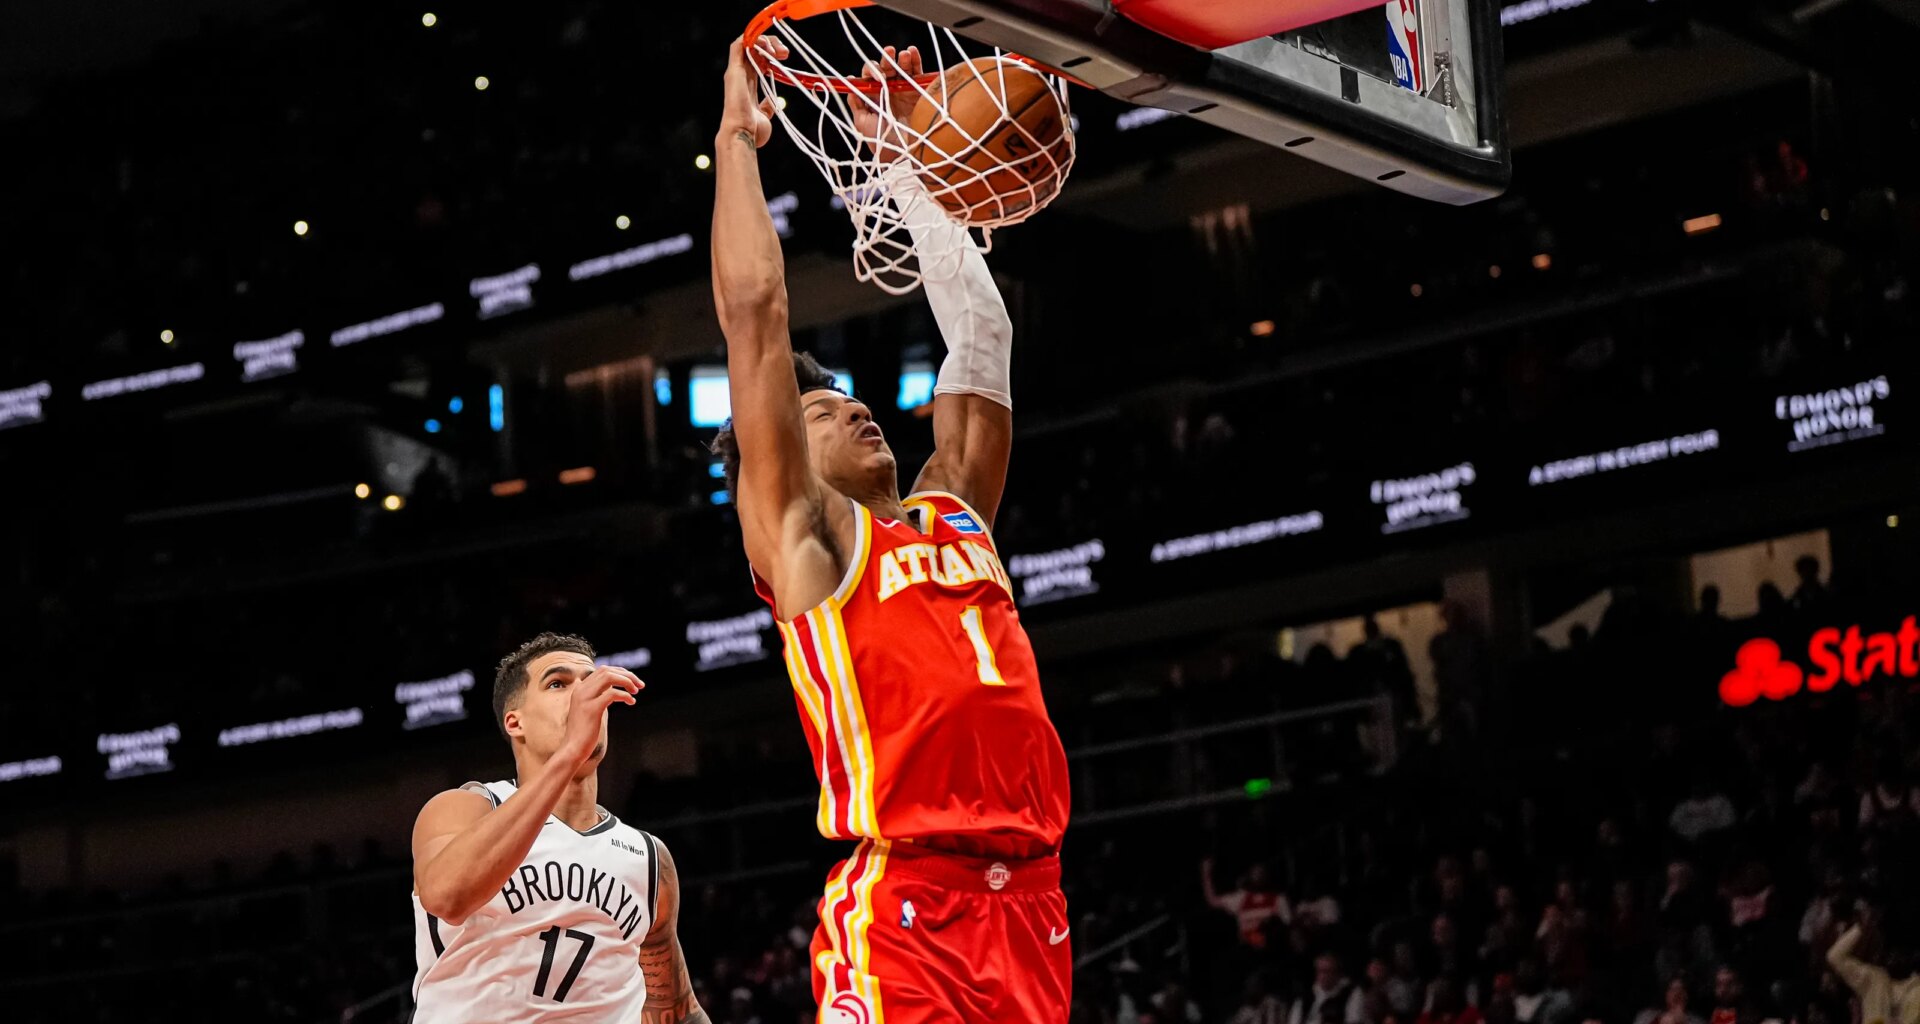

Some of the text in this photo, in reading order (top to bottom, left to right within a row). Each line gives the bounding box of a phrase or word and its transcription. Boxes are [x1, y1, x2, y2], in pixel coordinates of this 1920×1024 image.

[1793, 405, 1874, 442] HONOR
[877, 540, 1012, 604] ATLAN
[959, 605, 1007, 686] 1
[1807, 614, 1920, 692] Stat
[611, 838, 621, 848] All
[628, 844, 645, 856] Won
[501, 860, 642, 941] BROOKLYN
[532, 925, 596, 1003] 17
